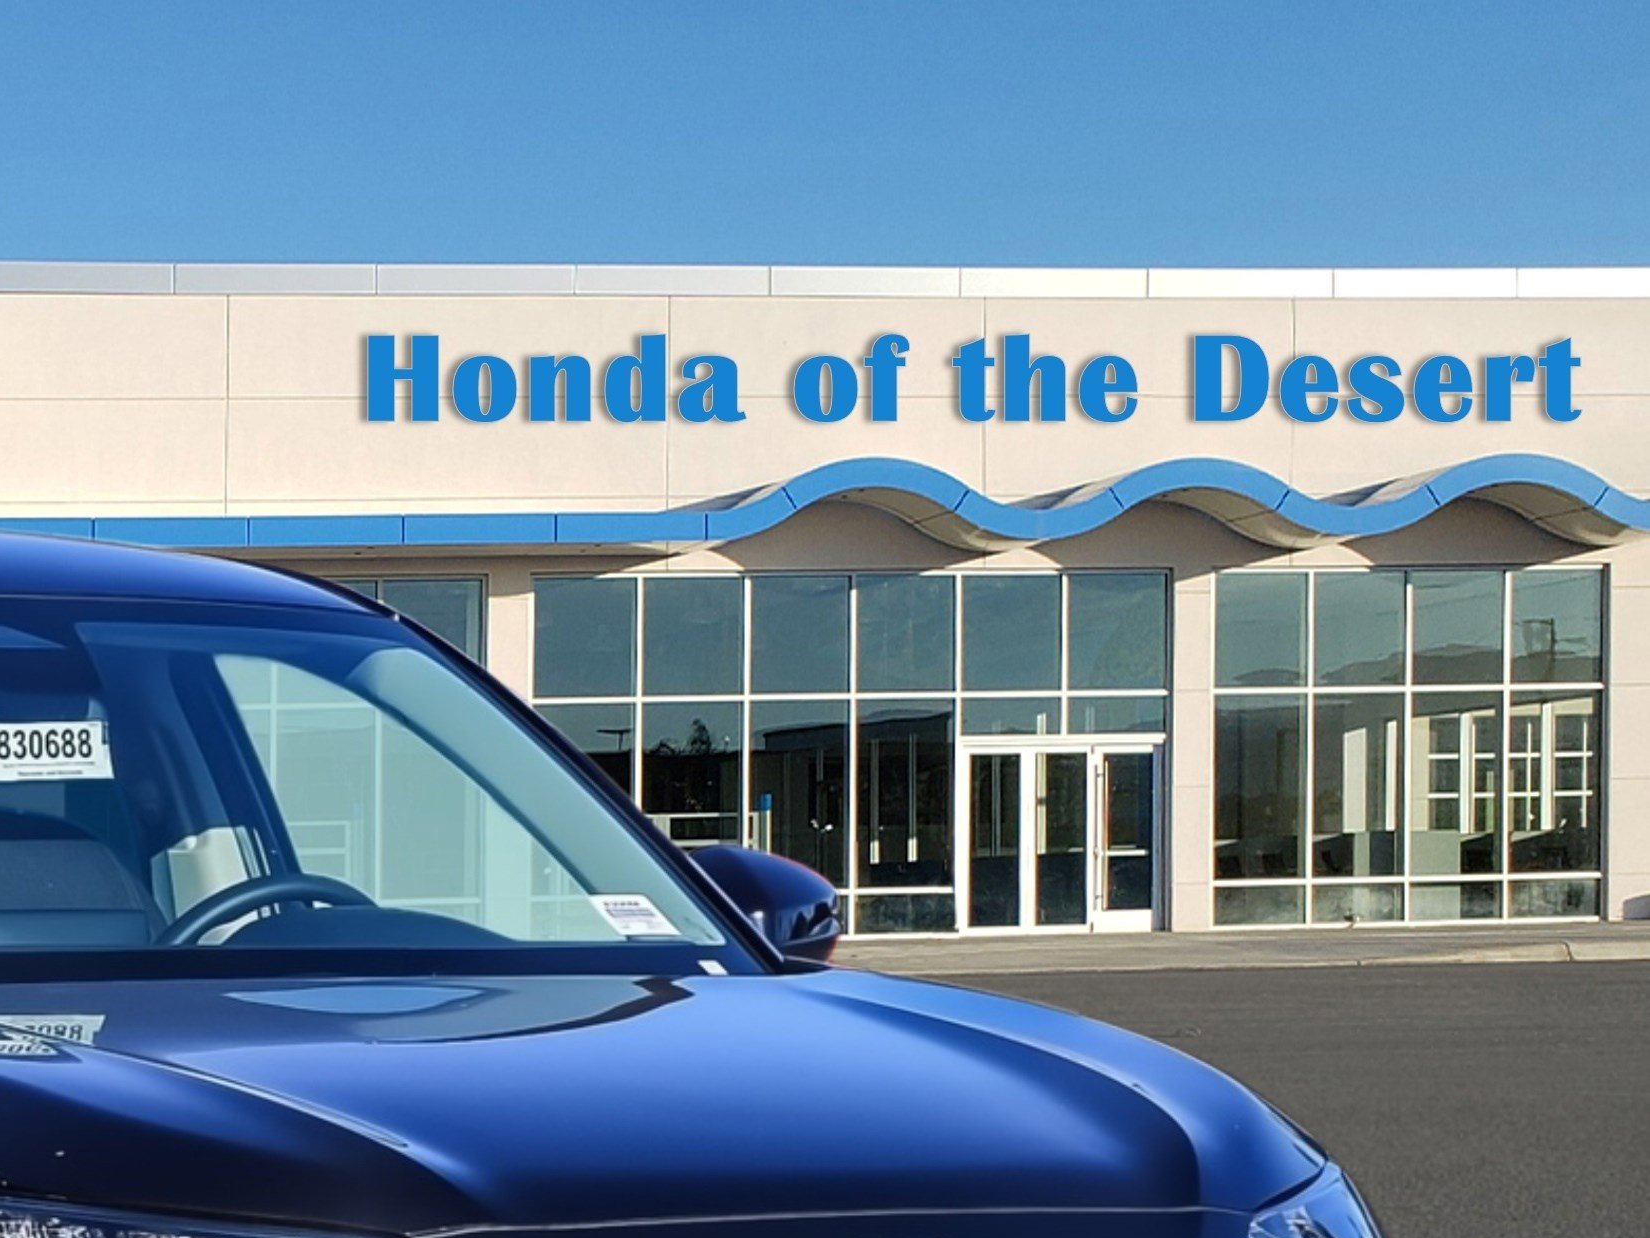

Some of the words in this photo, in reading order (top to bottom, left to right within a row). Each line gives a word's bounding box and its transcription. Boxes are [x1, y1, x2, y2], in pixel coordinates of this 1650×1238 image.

[367, 333, 747, 424] Honda
[793, 333, 910, 424] of
[951, 333, 1139, 424] the
[1193, 334, 1583, 424] Desert
